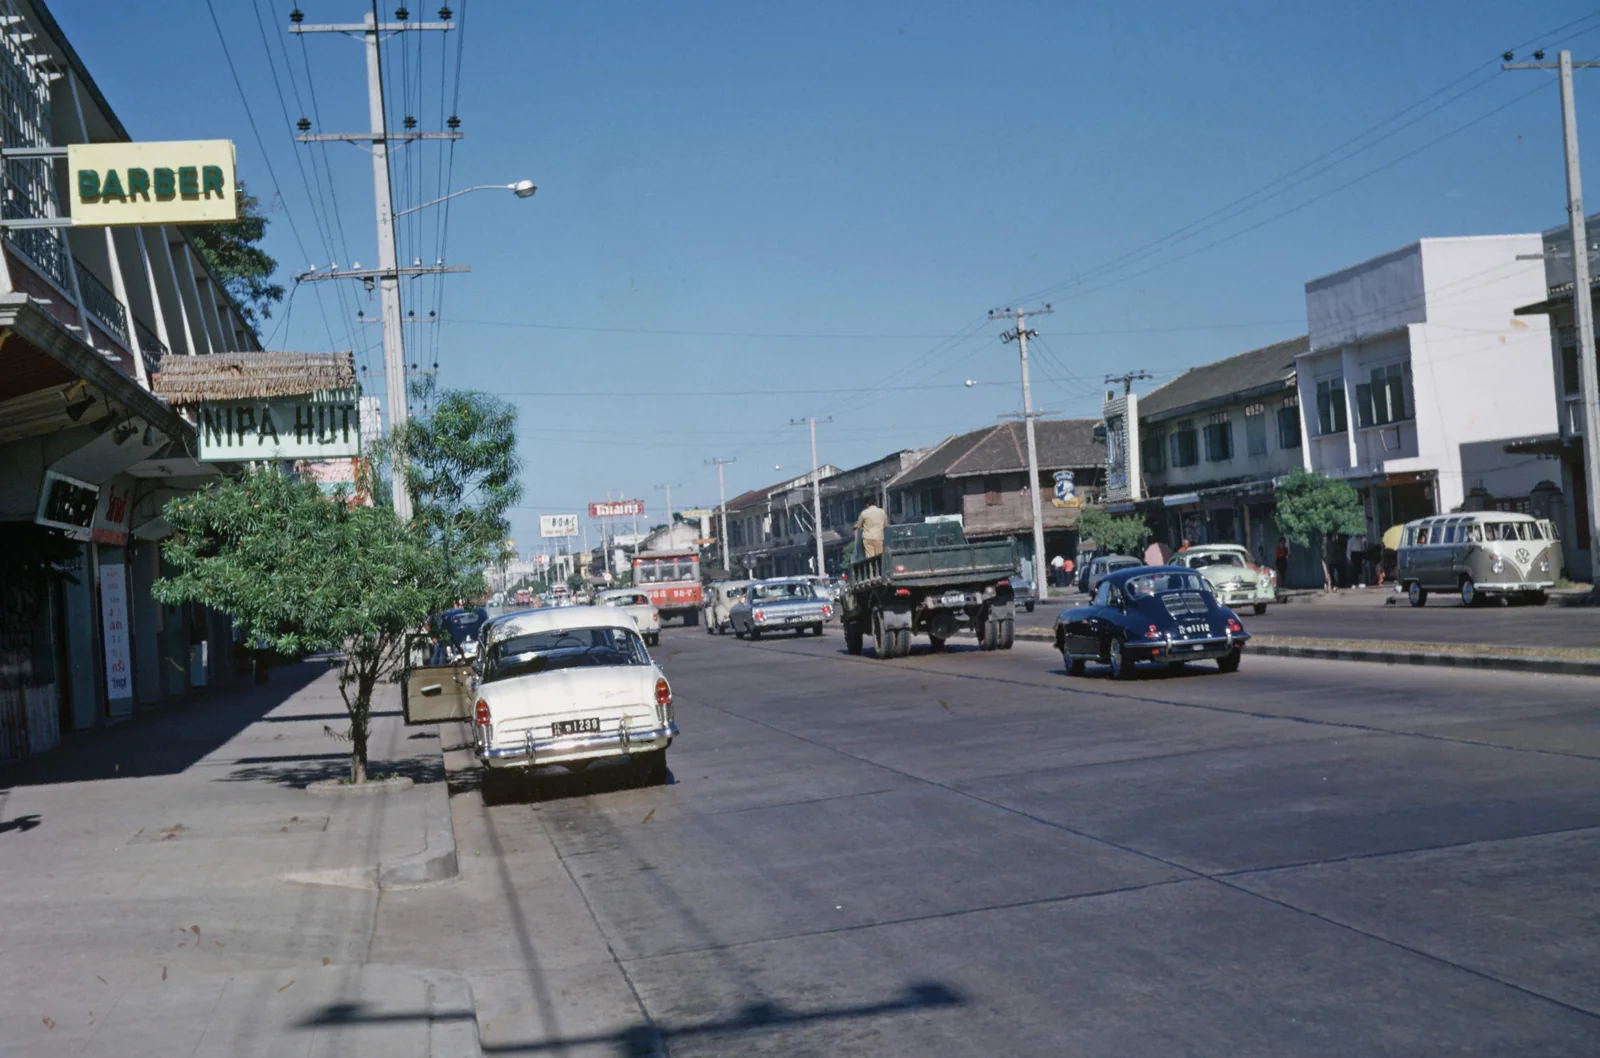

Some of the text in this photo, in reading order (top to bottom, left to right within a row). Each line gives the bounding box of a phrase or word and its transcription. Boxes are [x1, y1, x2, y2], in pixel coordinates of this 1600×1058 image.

[78, 164, 225, 201] BARBER
[204, 404, 356, 448] NIPA HUT
